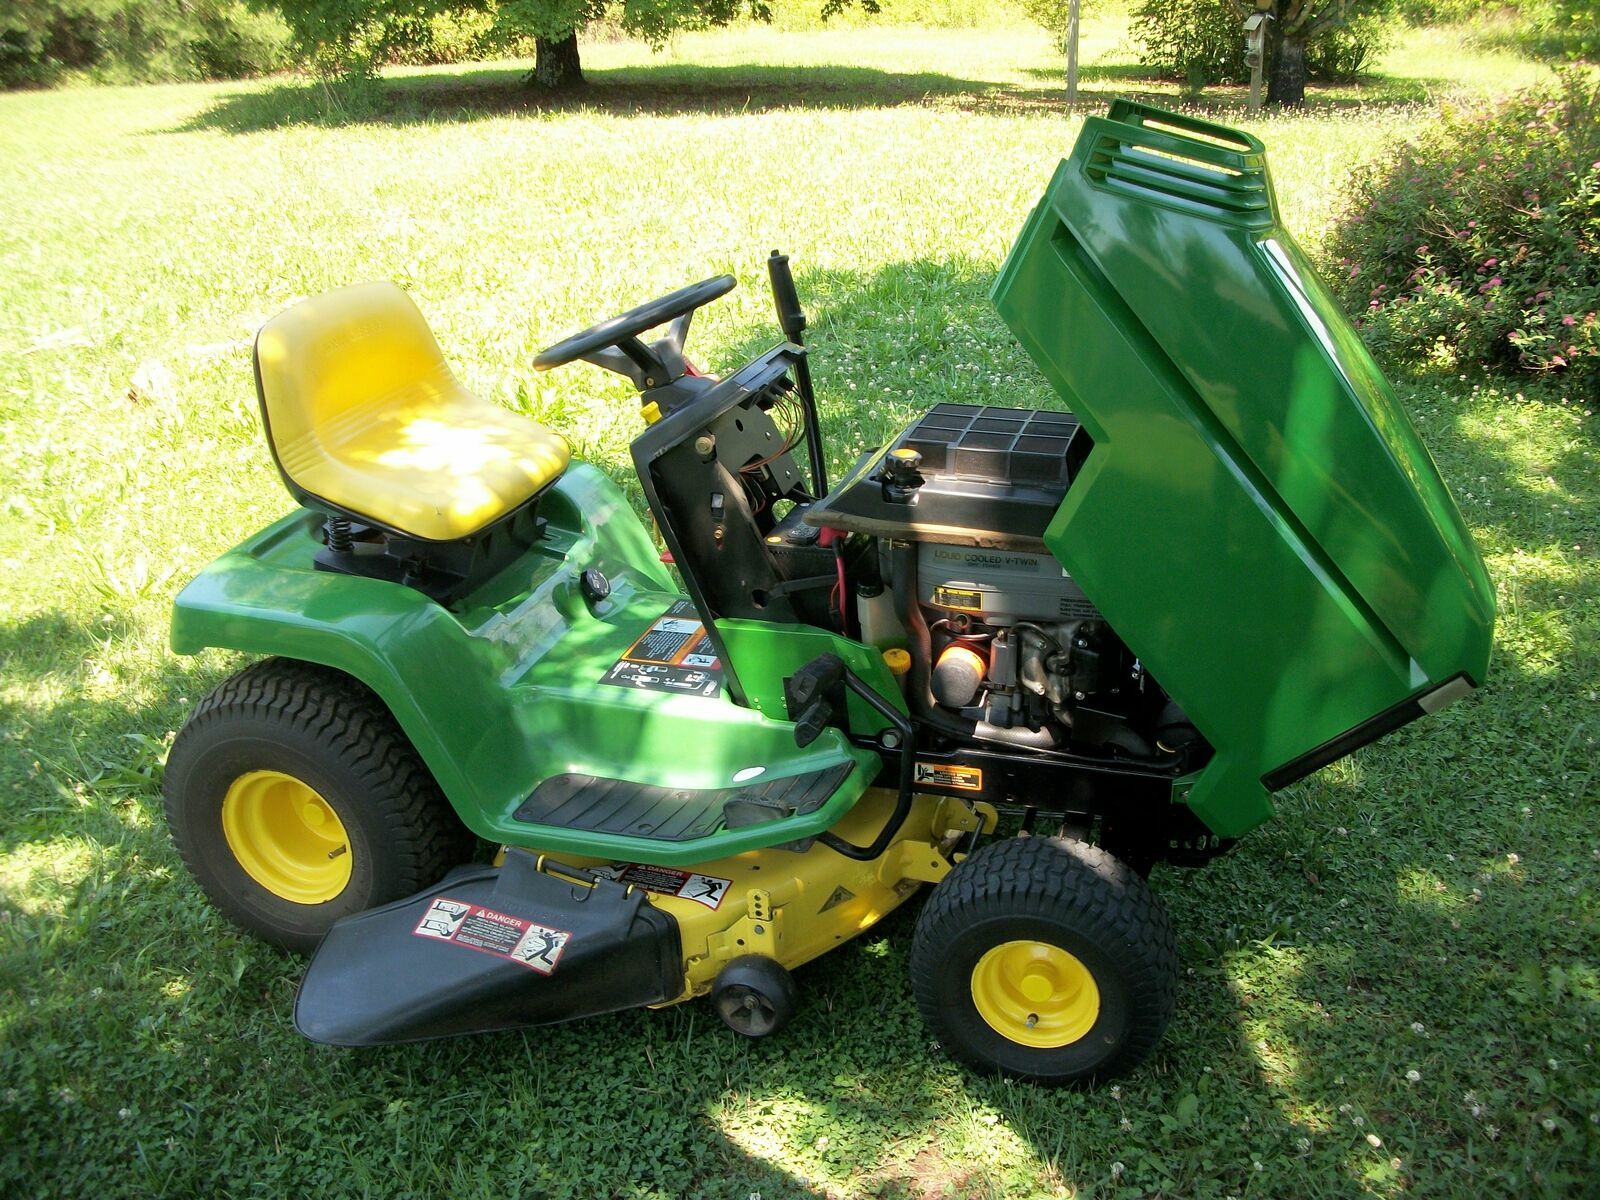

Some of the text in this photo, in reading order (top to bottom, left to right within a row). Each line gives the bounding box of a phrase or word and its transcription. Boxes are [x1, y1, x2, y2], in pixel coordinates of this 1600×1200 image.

[964, 553, 1002, 564] COOLED
[1005, 557, 1038, 567] V-TWIN
[647, 865, 684, 877] DANGER
[486, 912, 522, 927] DANGER
